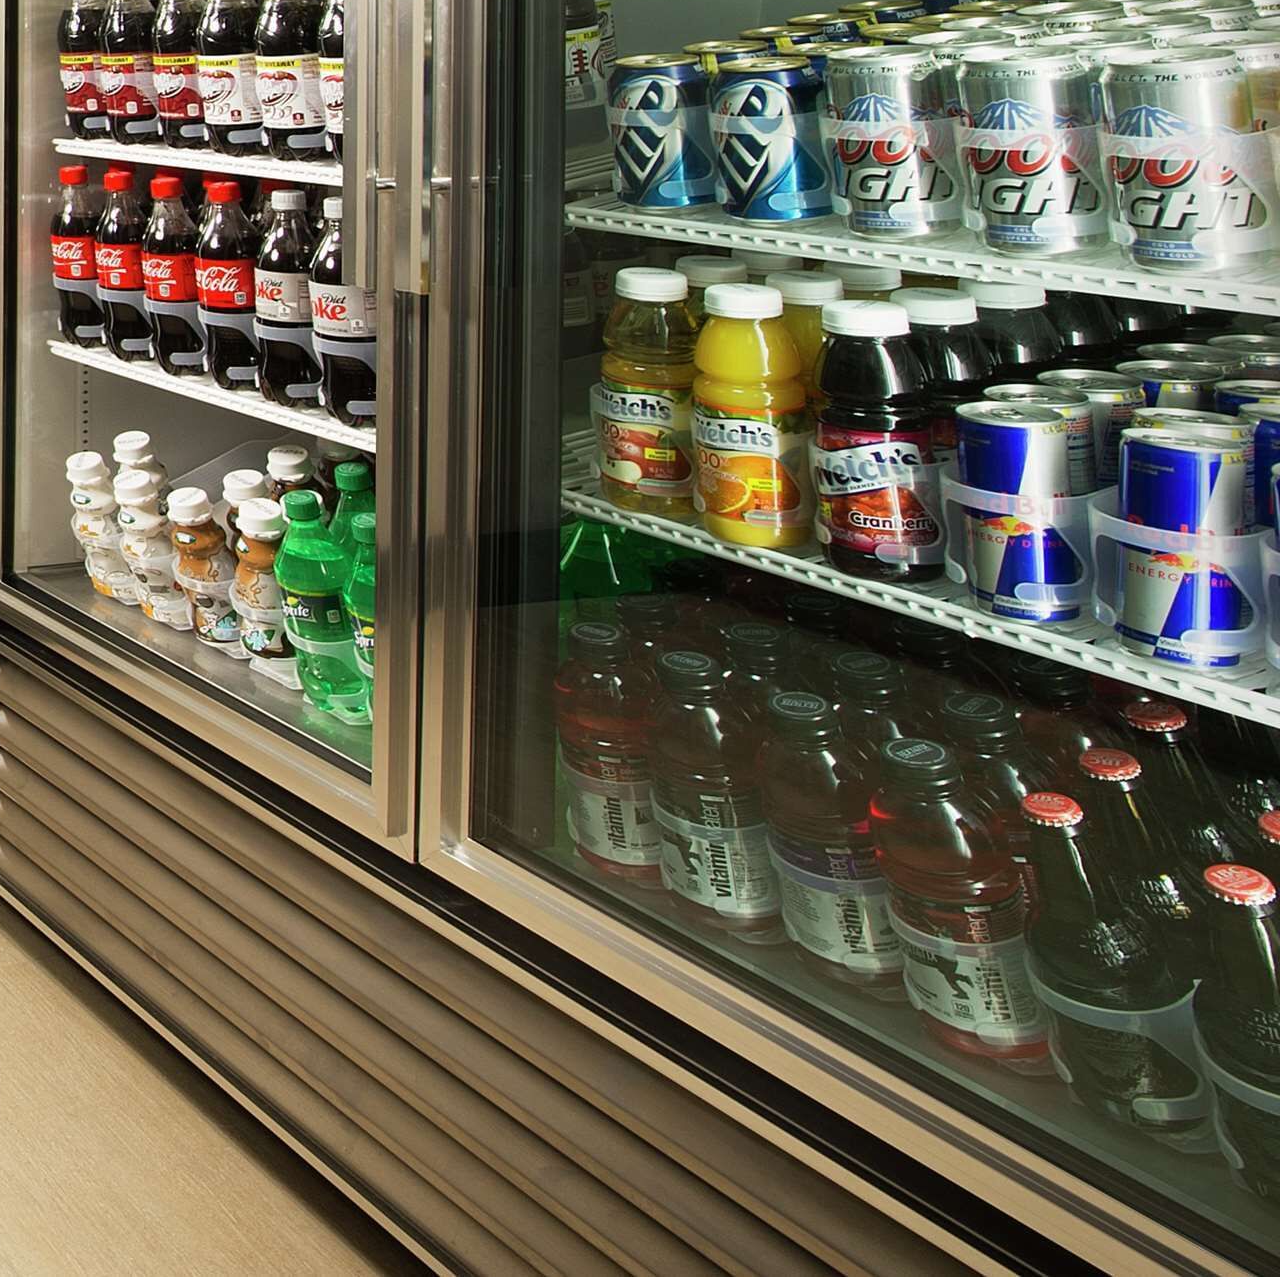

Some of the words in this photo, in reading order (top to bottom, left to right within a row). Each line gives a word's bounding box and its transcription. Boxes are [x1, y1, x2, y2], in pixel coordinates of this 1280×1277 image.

[1154, 73, 1179, 82] THE
[1168, 251, 1195, 259] COLD
[256, 281, 283, 301] oke
[264, 278, 283, 288] Diet
[322, 293, 346, 304] Diet
[312, 297, 347, 321] oke
[603, 422, 630, 440] 00%
[696, 418, 773, 448] Welch's
[698, 447, 728, 468] 00%
[815, 449, 921, 486] Welch's
[849, 511, 936, 531] Cranberry
[1128, 562, 1192, 585] ENERGY
[604, 796, 627, 850] vitamin
[706, 841, 732, 898] vitamin
